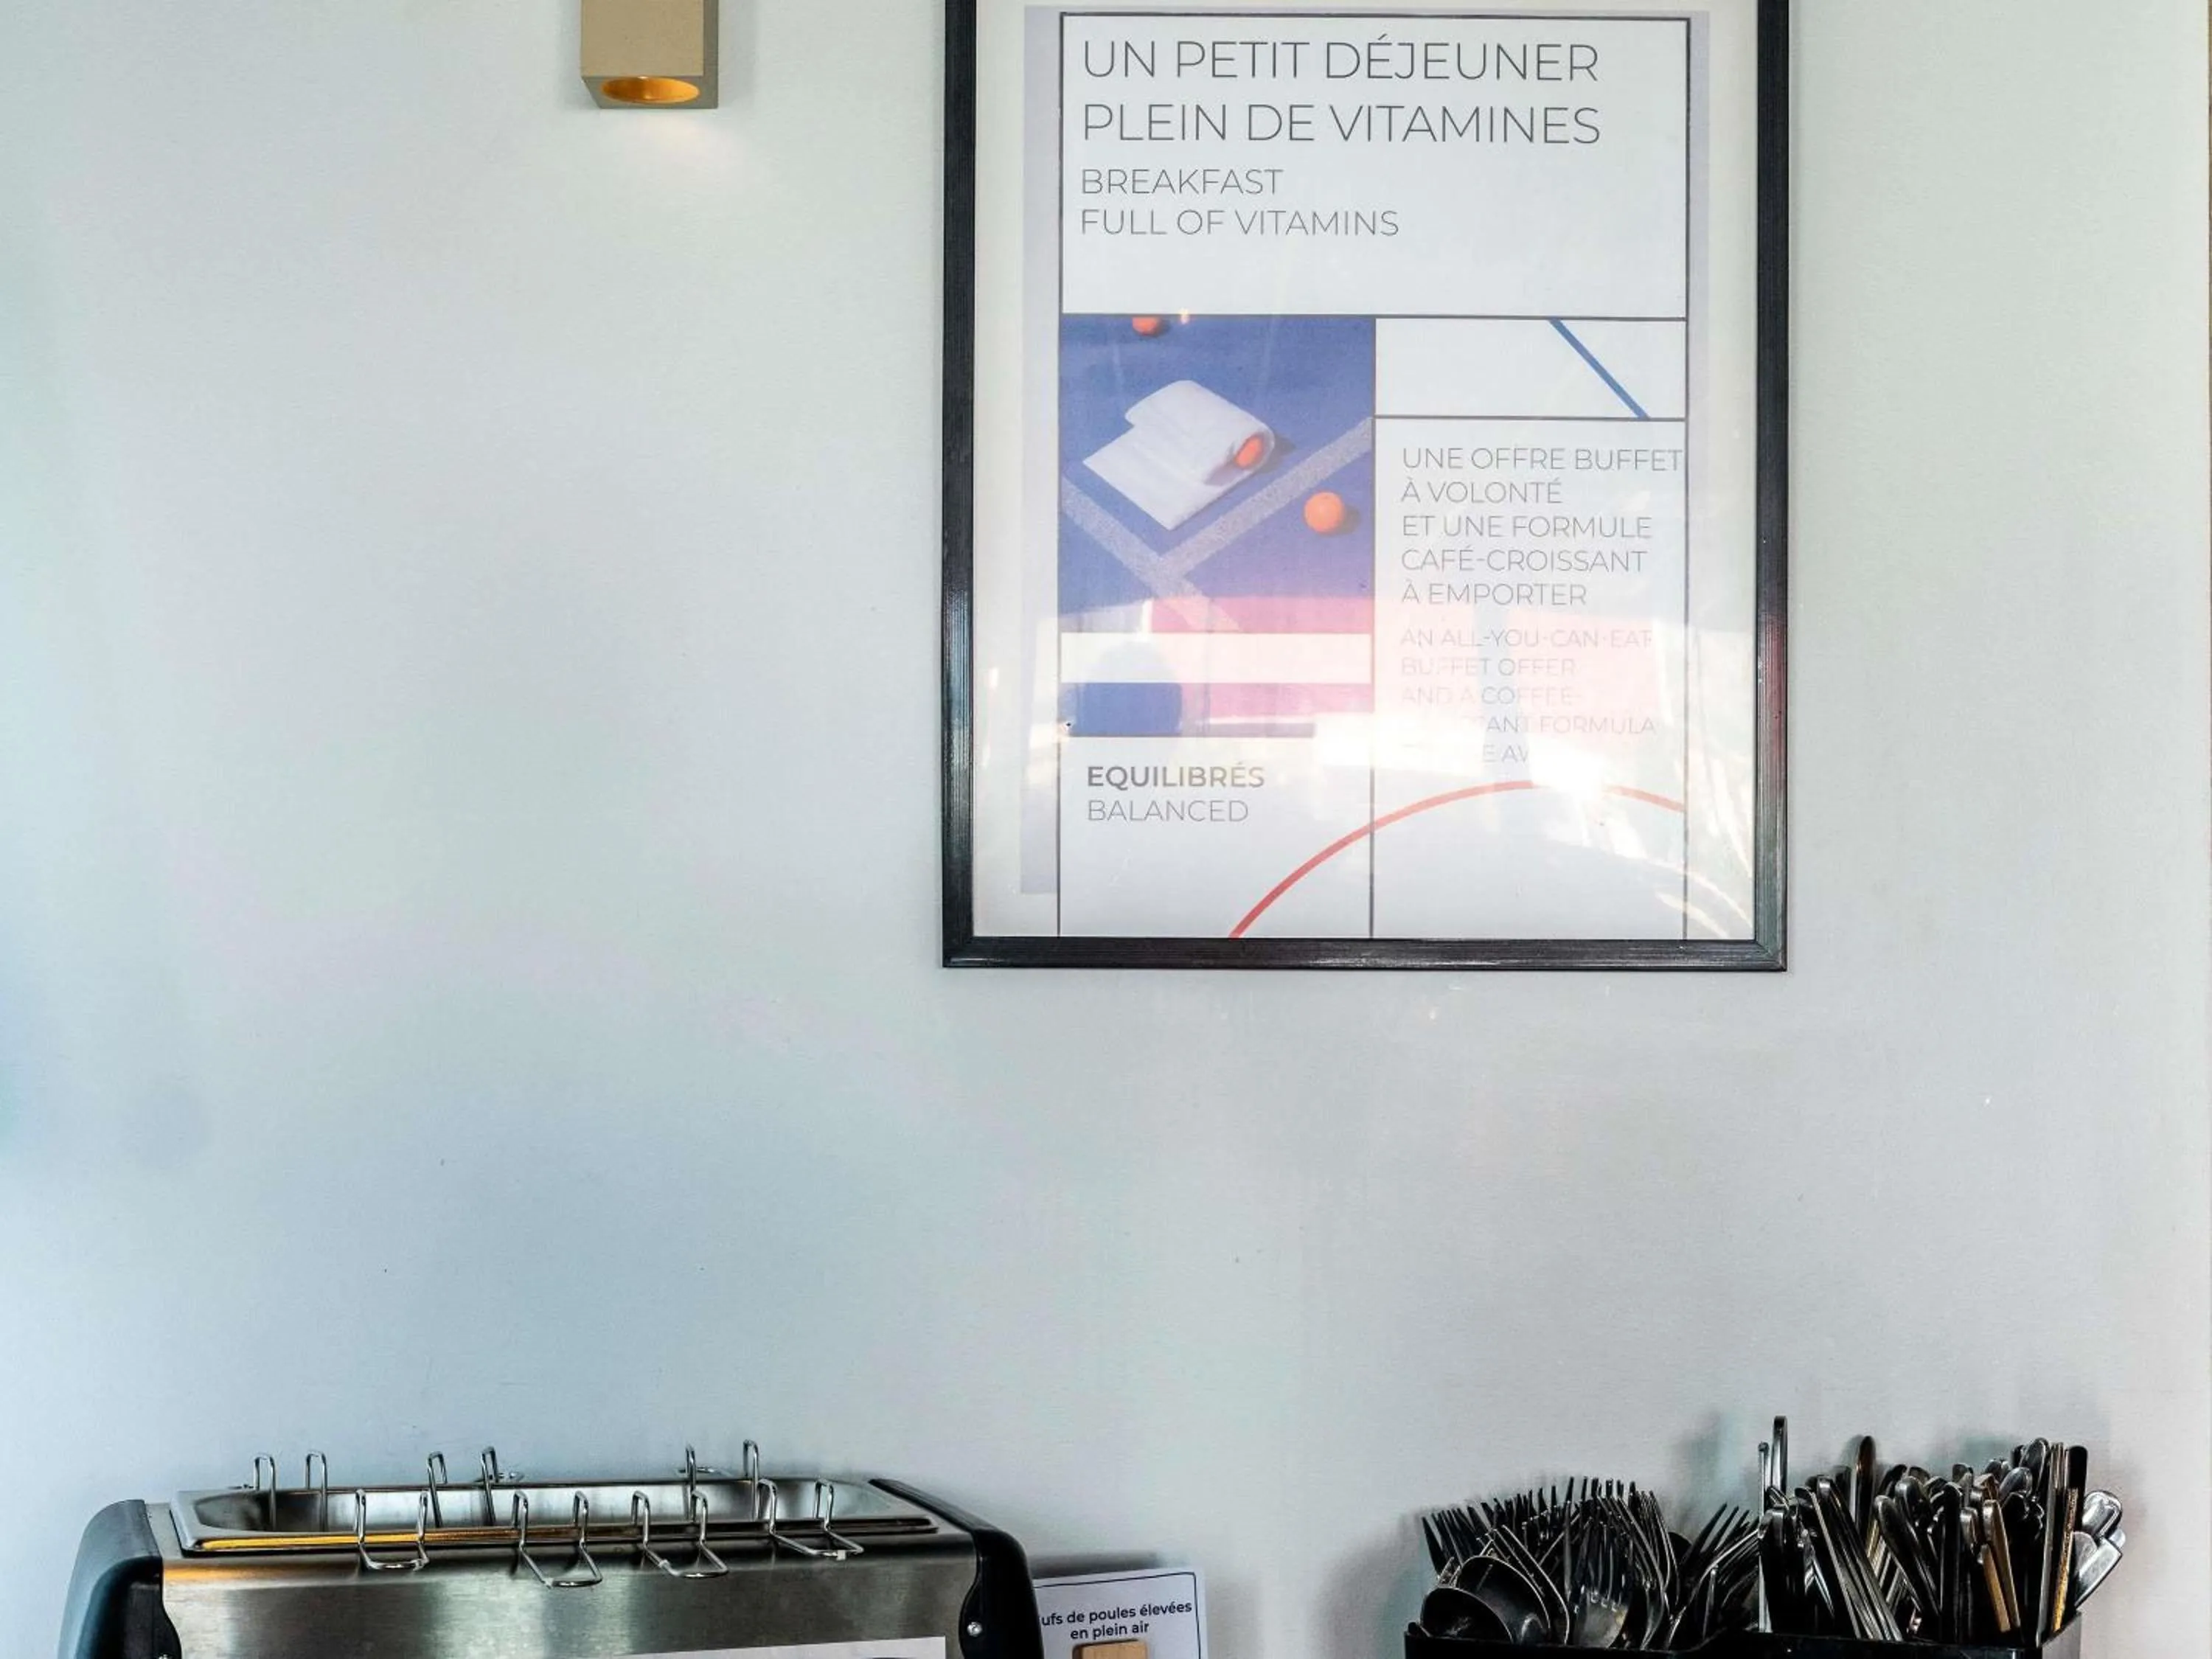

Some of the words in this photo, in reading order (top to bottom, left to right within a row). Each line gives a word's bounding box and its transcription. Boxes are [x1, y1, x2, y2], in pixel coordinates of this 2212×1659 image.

[1085, 40, 1155, 79] UN
[1177, 41, 1308, 80] PETIT
[1326, 34, 1598, 81] DÉJEUNER
[1085, 104, 1226, 141] PLEIN
[1248, 104, 1315, 142] DE
[1329, 105, 1601, 144] VITAMINES
[1082, 169, 1283, 195] BREAKFAST
[1082, 209, 1166, 235] FULL
[1177, 209, 1224, 236] OF
[1235, 210, 1399, 236] VITAMINS
[1403, 448, 1463, 469] UNE
[1472, 448, 1565, 470] OFFRE
[1576, 449, 1682, 471] BUFFET
[1401, 478, 1420, 502] À
[1427, 477, 1562, 504] VOLONTÉ
[1403, 516, 1434, 537] ET
[1444, 516, 1503, 538] UNE
[1513, 517, 1652, 538] FORMULE
[1402, 546, 1648, 572] CAFÉ-CROISSANT
[1401, 580, 1419, 604] À
[1429, 584, 1587, 605] EMPORTER
[1401, 629, 1433, 647] AN
[1541, 716, 1657, 735] FORMULA
[1088, 762, 1265, 790] EQUILIBRÉS
[1088, 801, 1249, 821] BALANCED
[1039, 1613, 1063, 1626] ufs
[1067, 1610, 1085, 1623] de
[1089, 1607, 1136, 1622] poules
[1140, 1601, 1192, 1617] élevées
[1070, 1627, 1089, 1639] en
[1093, 1622, 1128, 1640] plein
[1132, 1621, 1150, 1633] air
